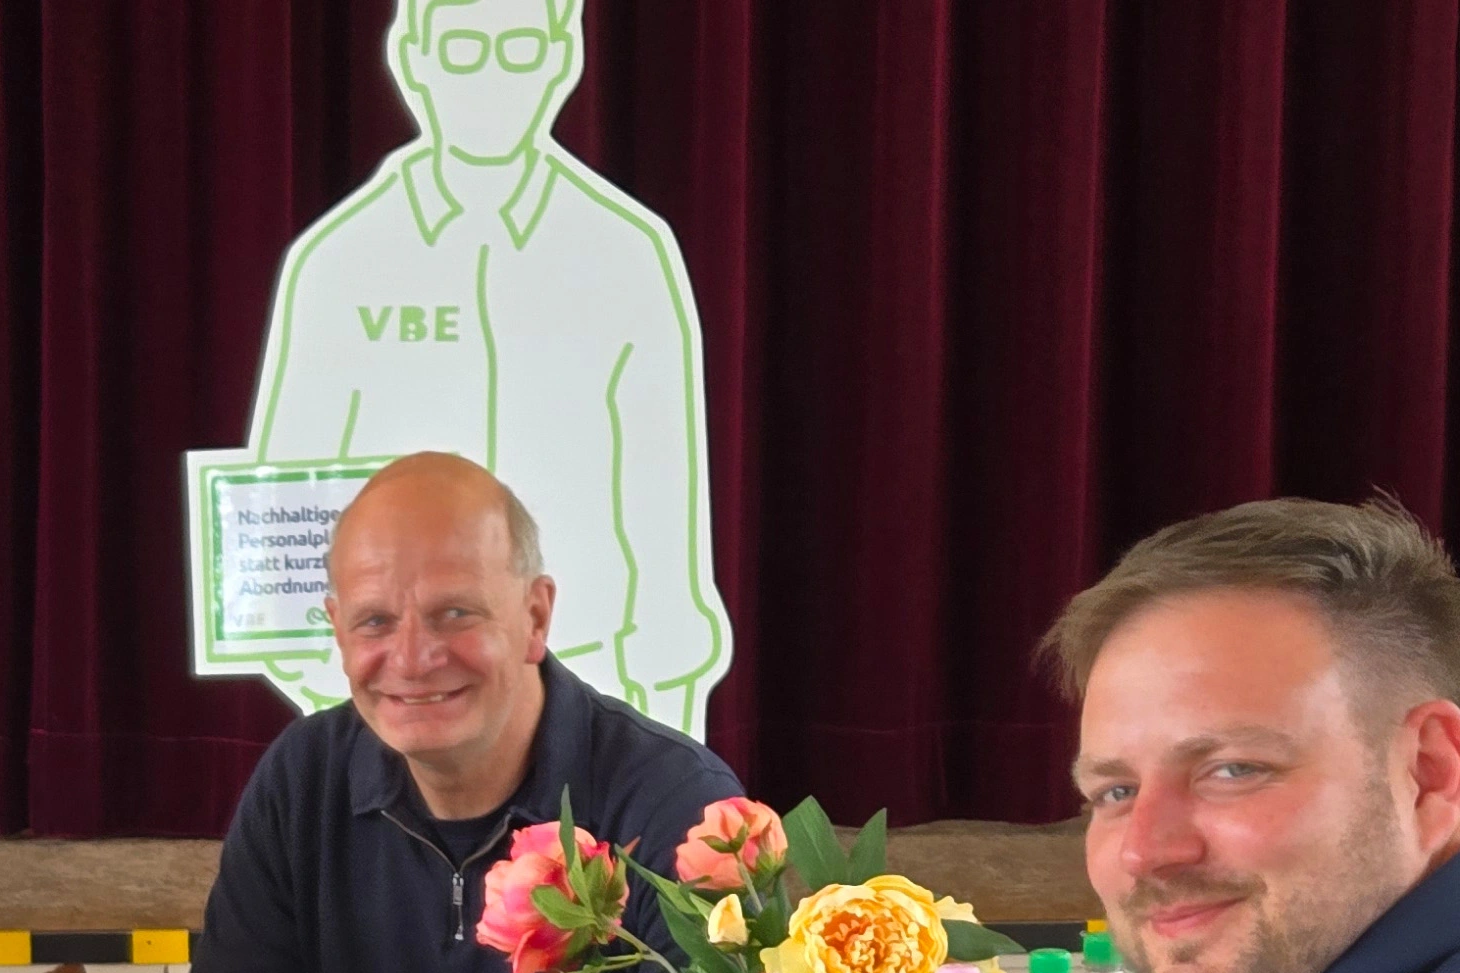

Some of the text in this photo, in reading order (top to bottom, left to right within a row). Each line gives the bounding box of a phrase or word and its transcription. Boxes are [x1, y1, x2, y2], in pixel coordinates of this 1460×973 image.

[357, 304, 460, 342] VBE
[238, 529, 330, 549] Personalpl
[240, 577, 329, 596] Abordnun
